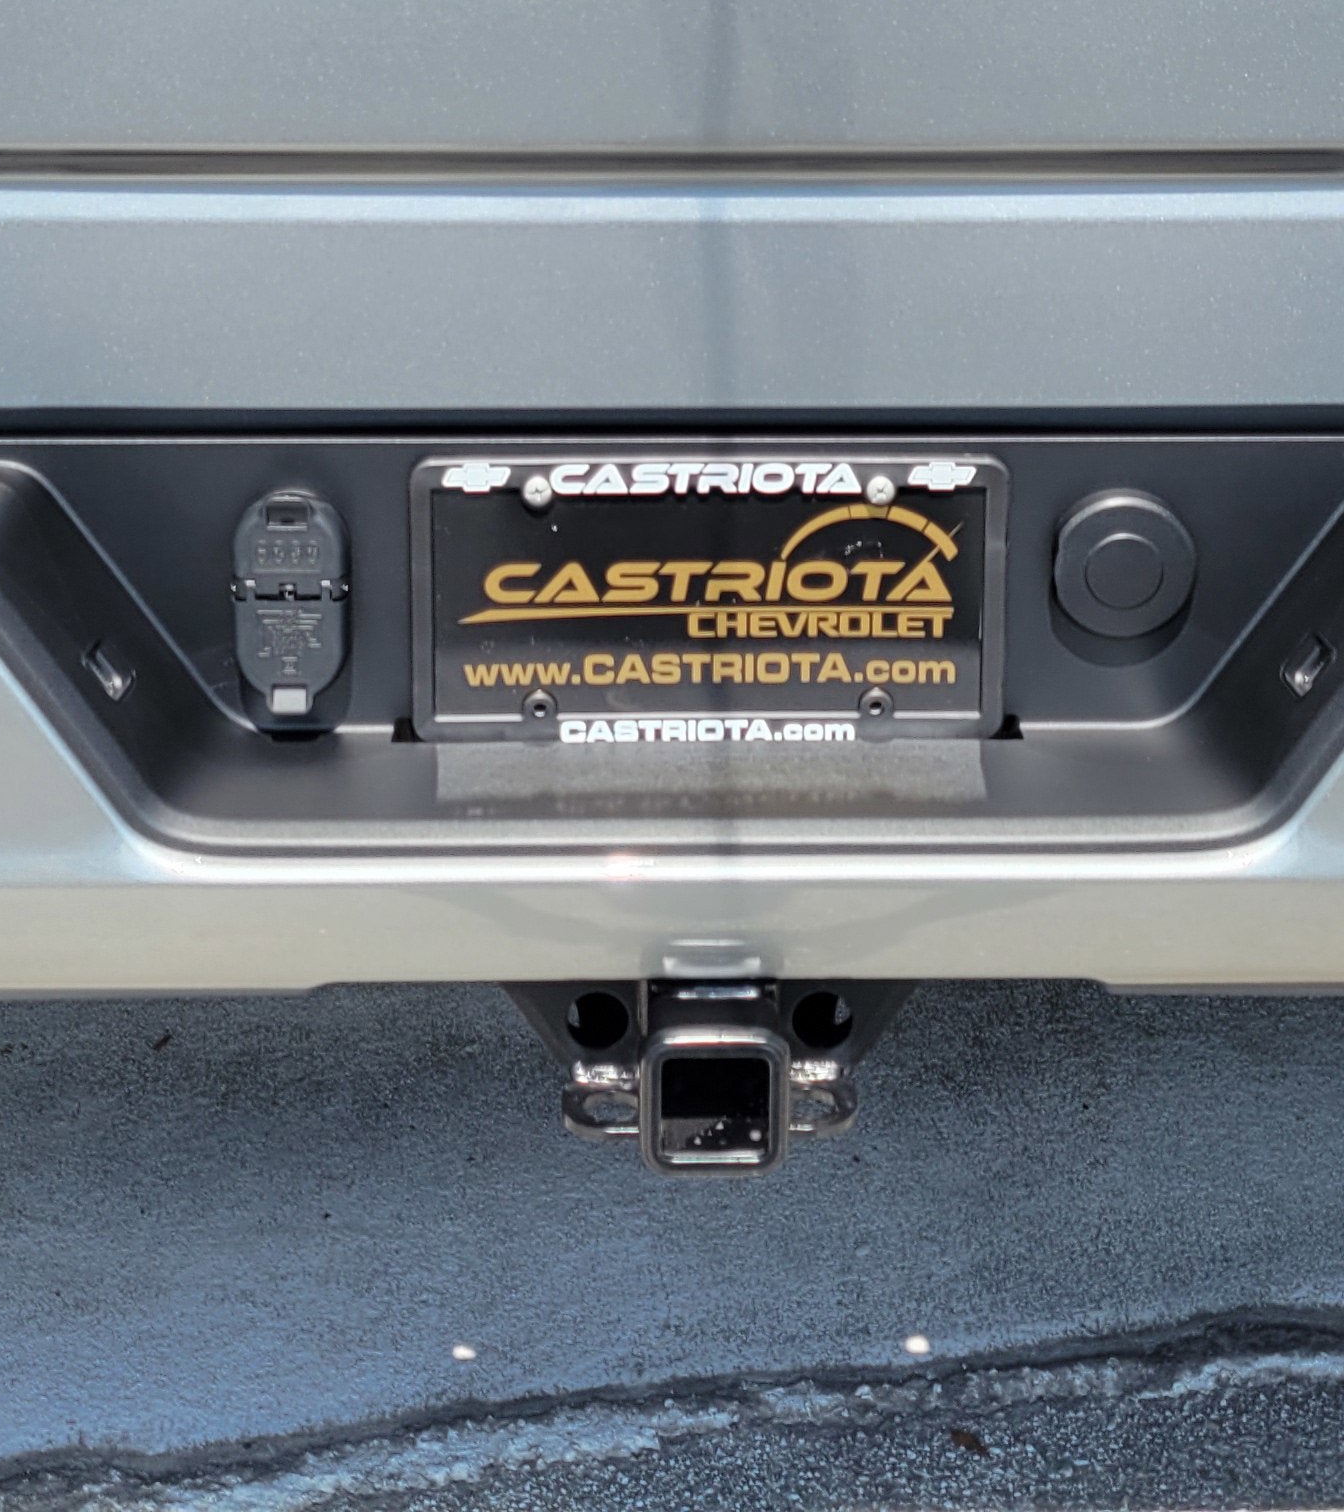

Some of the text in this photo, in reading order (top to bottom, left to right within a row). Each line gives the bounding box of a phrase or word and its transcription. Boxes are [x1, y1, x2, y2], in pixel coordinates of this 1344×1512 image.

[550, 462, 862, 495] CASTRIOTA
[484, 560, 952, 604] CASTRIOTA
[687, 610, 953, 638] CHEVROLET
[464, 652, 956, 687] www.CASTRIOTA.com
[560, 719, 855, 743] CASTRIOTA.com
